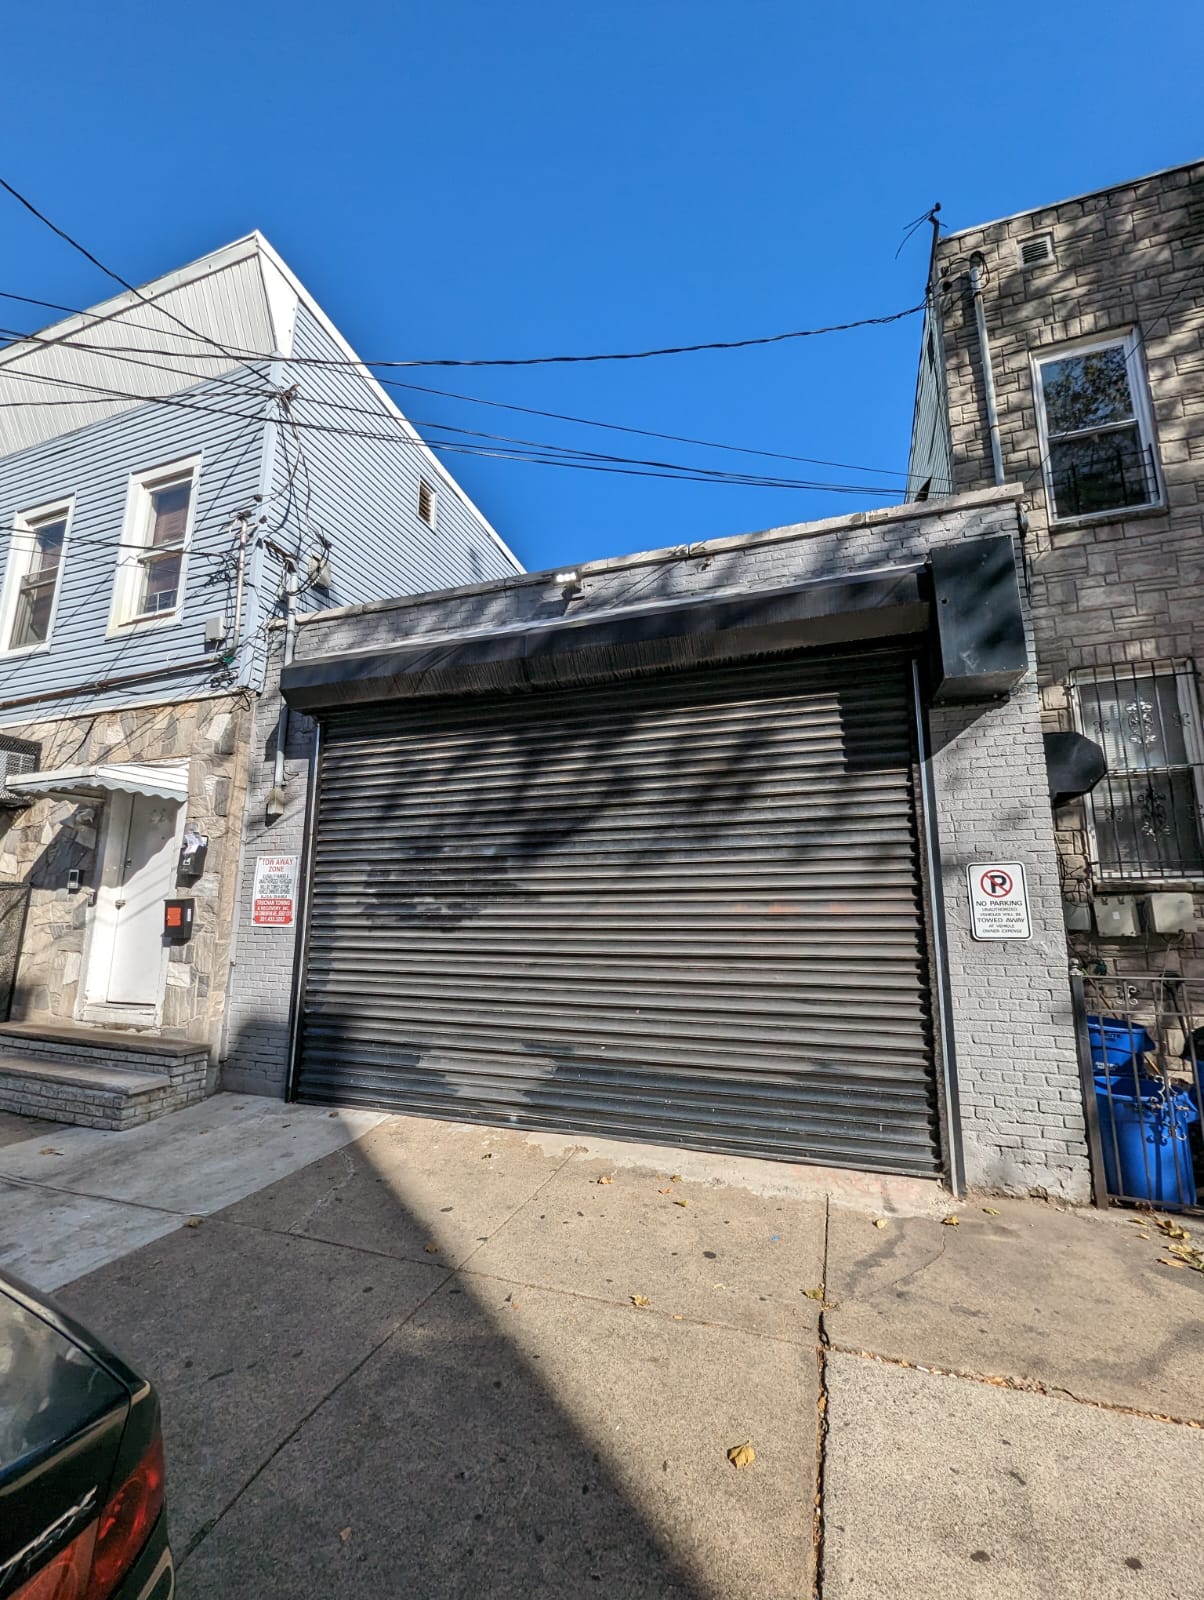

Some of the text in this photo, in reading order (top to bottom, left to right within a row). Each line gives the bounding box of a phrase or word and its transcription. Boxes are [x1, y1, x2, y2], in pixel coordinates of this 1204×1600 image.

[262, 858, 293, 866] TOW AWAY
[990, 875, 1007, 893] P
